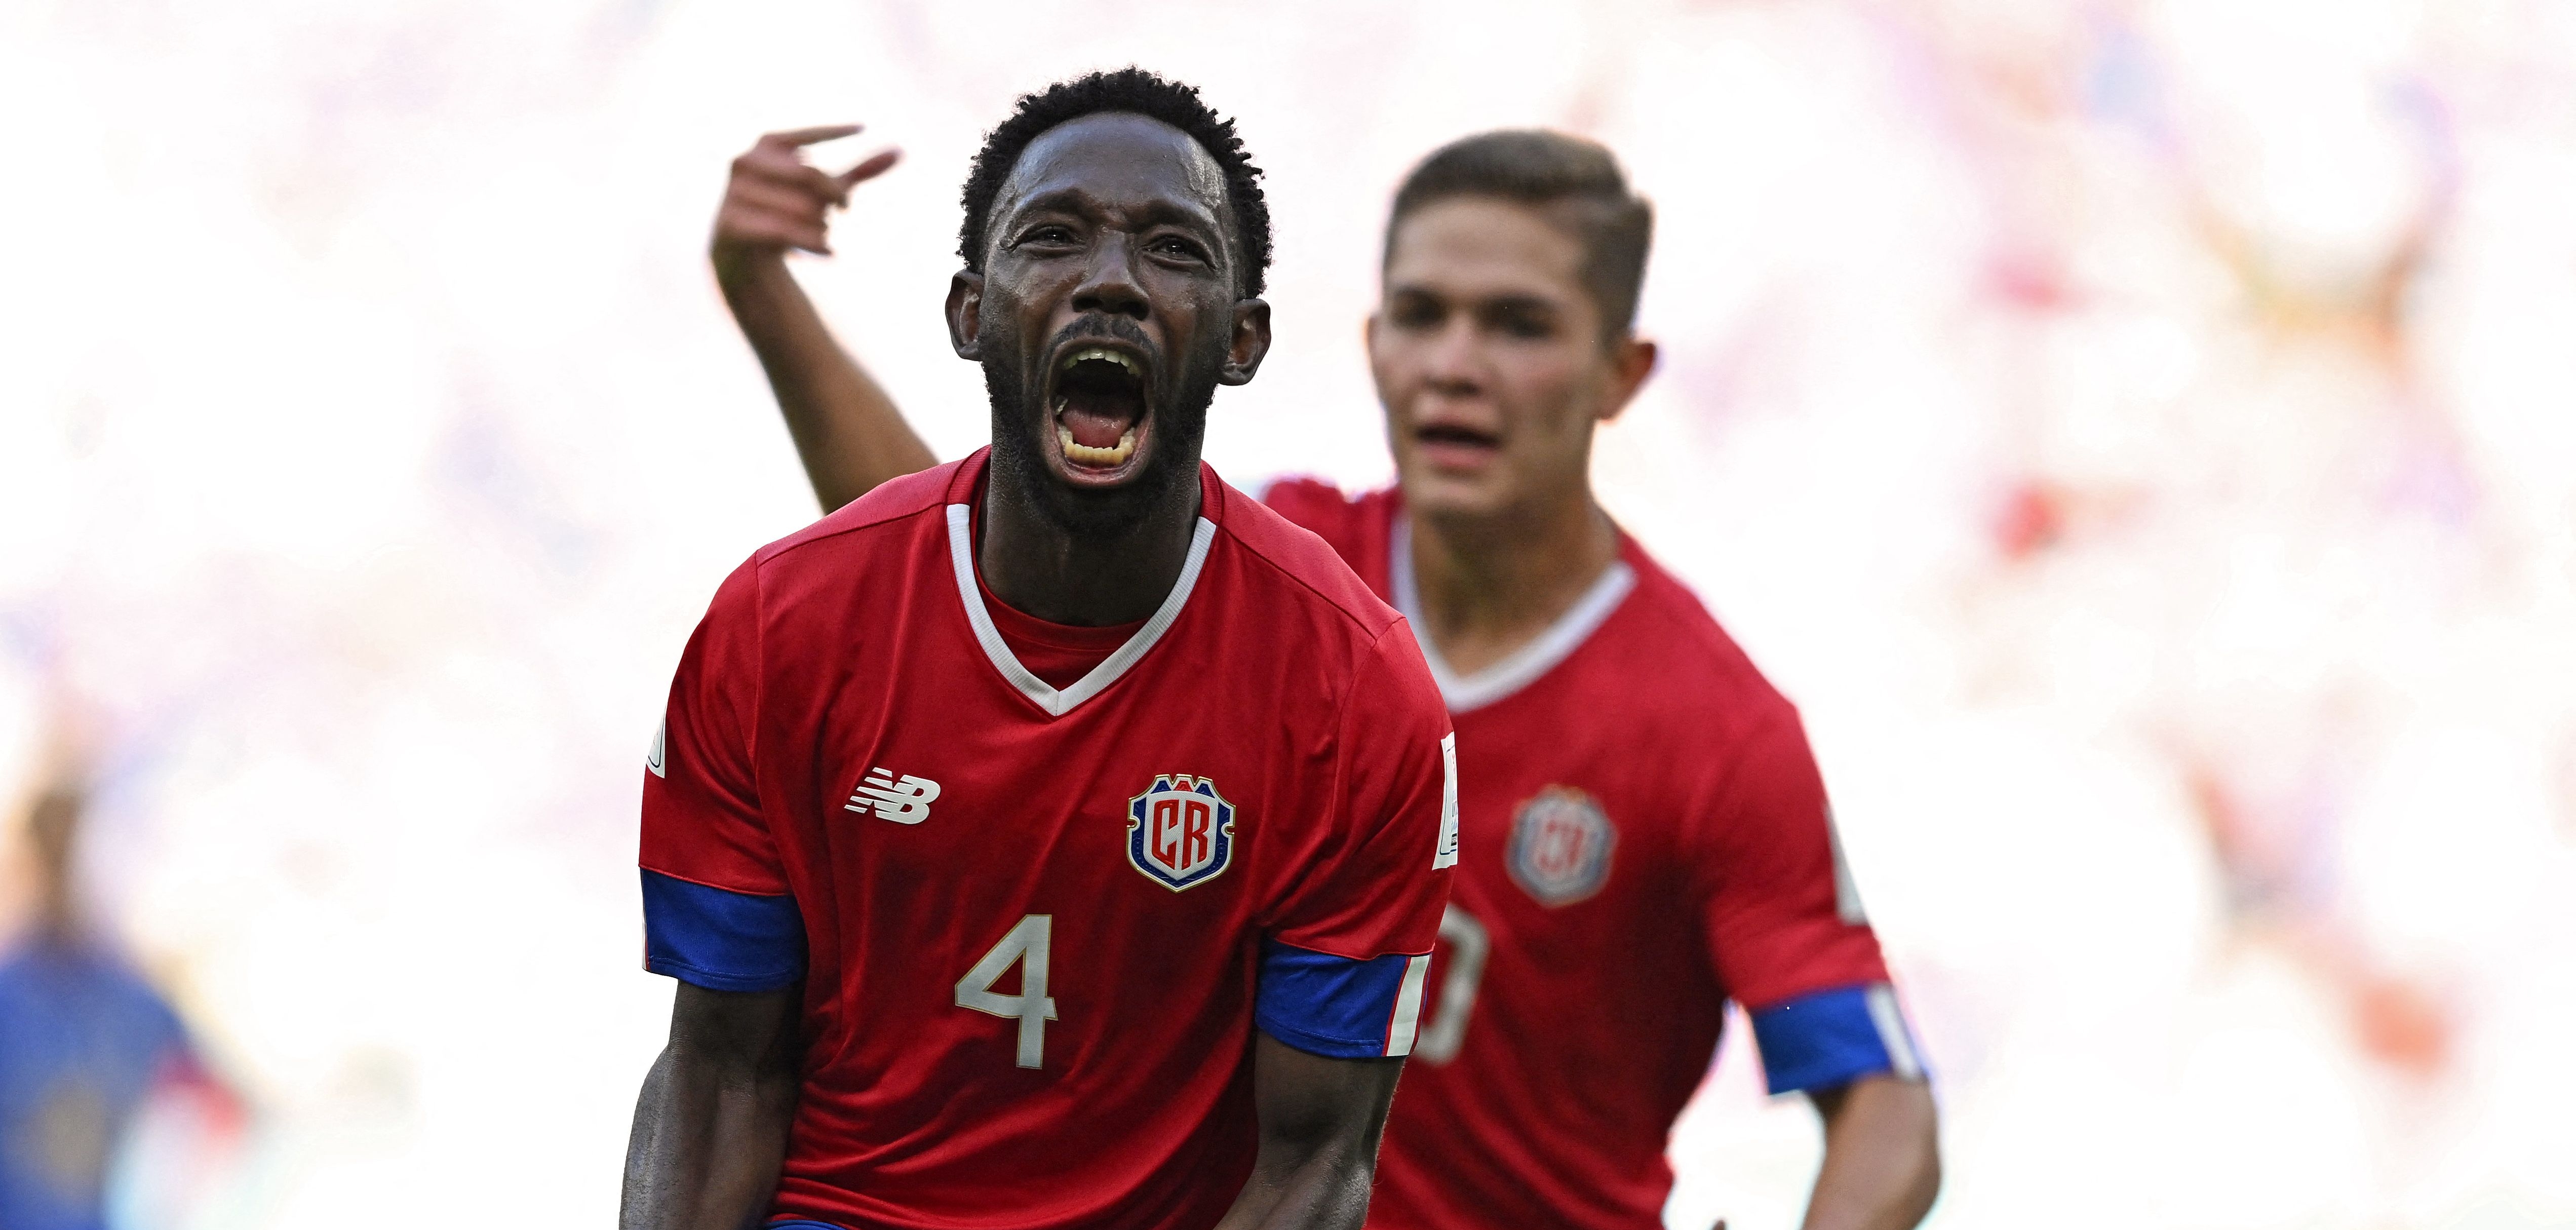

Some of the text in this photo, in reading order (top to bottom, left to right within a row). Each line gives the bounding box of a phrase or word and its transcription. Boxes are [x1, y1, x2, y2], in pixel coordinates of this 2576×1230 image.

[844, 767, 941, 824] NB
[1151, 799, 1210, 870] CR
[955, 914, 1059, 1069] 4
